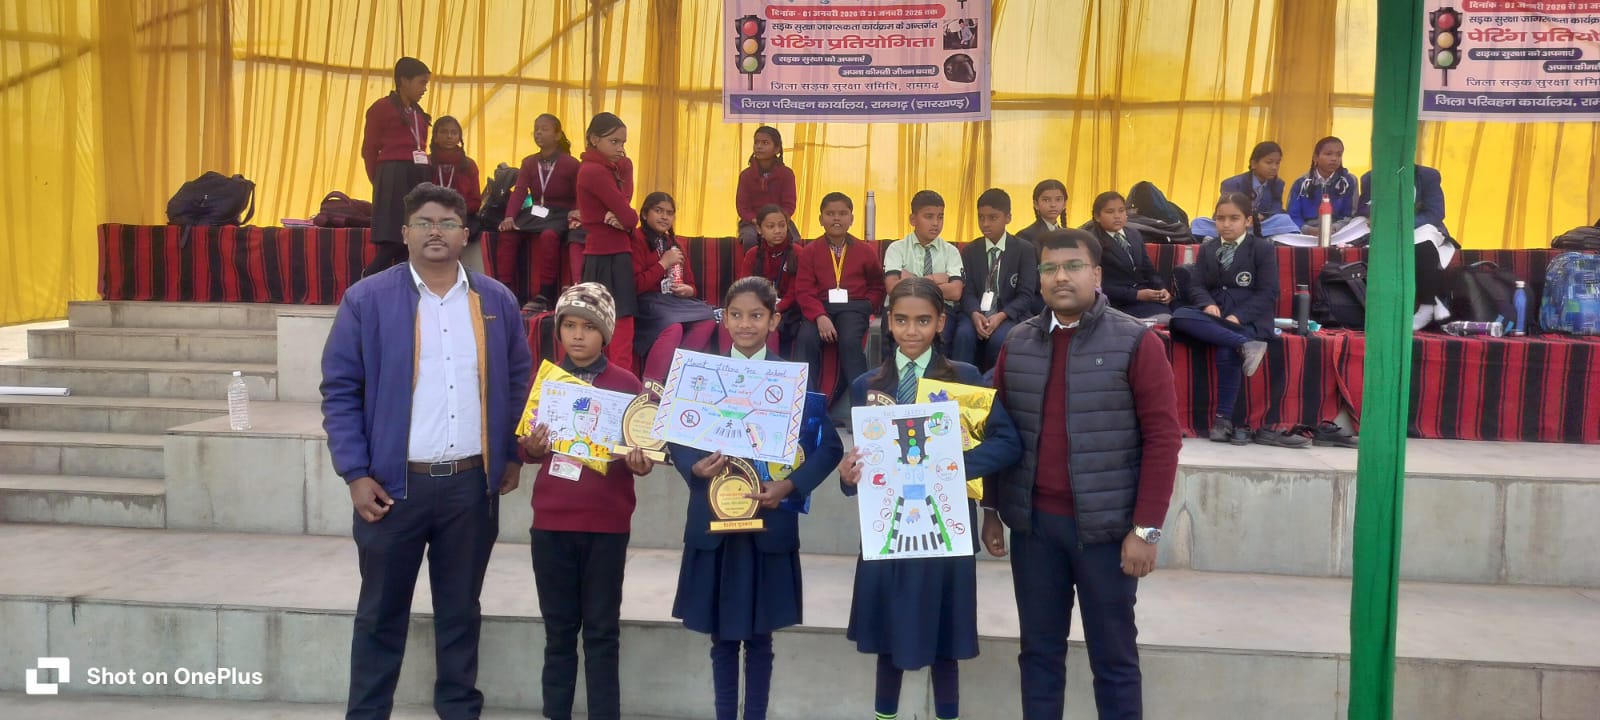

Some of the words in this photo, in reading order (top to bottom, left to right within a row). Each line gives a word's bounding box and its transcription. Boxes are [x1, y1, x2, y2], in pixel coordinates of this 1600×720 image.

[1469, 1, 1497, 9] दिनांक
[771, 8, 796, 17] दिनांक
[813, 9, 839, 17] जनवरी
[878, 9, 903, 17] जनवरी
[1495, 16, 1518, 26] सुरक्षा
[794, 23, 815, 33] सुरक्षा
[862, 22, 894, 31] कार्यक्रम
[1531, 27, 1600, 44] प्रतियो
[827, 34, 936, 50] प्रतियोगिता
[1501, 50, 1525, 59] सुरक्षा
[802, 56, 823, 65] सुरक्षा
[865, 67, 891, 75] कीमती
[892, 67, 914, 75] जीवन
[771, 81, 797, 90] जिला
[800, 83, 829, 91] सड़क
[832, 83, 861, 92] सुरक्षा
[1466, 77, 1495, 86] जिला
[1500, 79, 1532, 88] सड़क
[1536, 79, 1569, 88] सुरक्षा
[1573, 77, 1600, 86] समि
[741, 98, 770, 109] जिला
[772, 98, 815, 110] परिवहन
[818, 98, 868, 110] कार्यालय,
[871, 101, 908, 111] रामगढ़
[1435, 94, 1465, 106] जिला
[1468, 96, 1516, 107] परिवहन
[1580, 98, 1600, 106] राम
